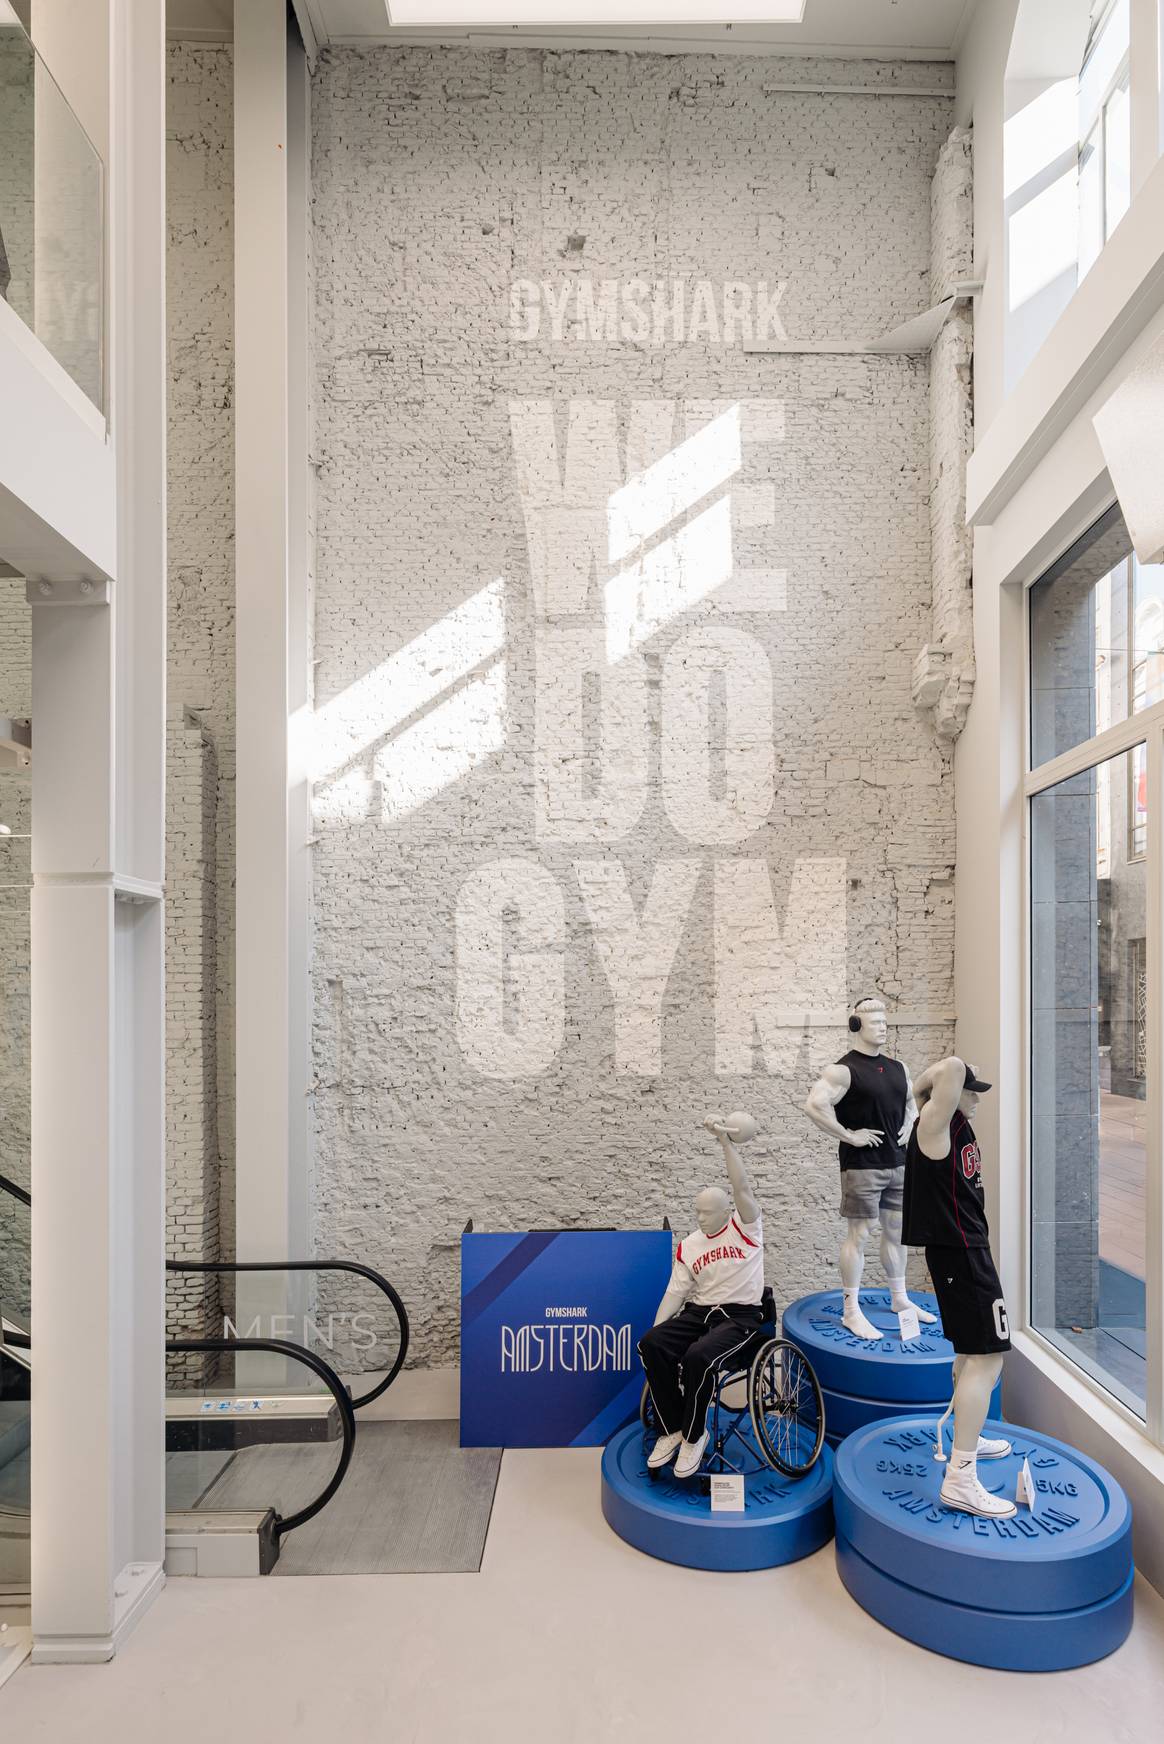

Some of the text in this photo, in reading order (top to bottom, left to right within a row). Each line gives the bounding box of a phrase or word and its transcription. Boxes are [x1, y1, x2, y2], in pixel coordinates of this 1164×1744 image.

[509, 278, 789, 342] GYMSHARK
[535, 626, 775, 846] DO
[454, 857, 848, 1080] GYM
[692, 1245, 747, 1275] GYMSHARK
[223, 1313, 378, 1350] MEN'S
[545, 1307, 588, 1318] GYMSHARK
[501, 1323, 632, 1373] AMSTERDAM
[1032, 1479, 1079, 1497] 5KG
[882, 1488, 1081, 1539] AMSTERDAM
